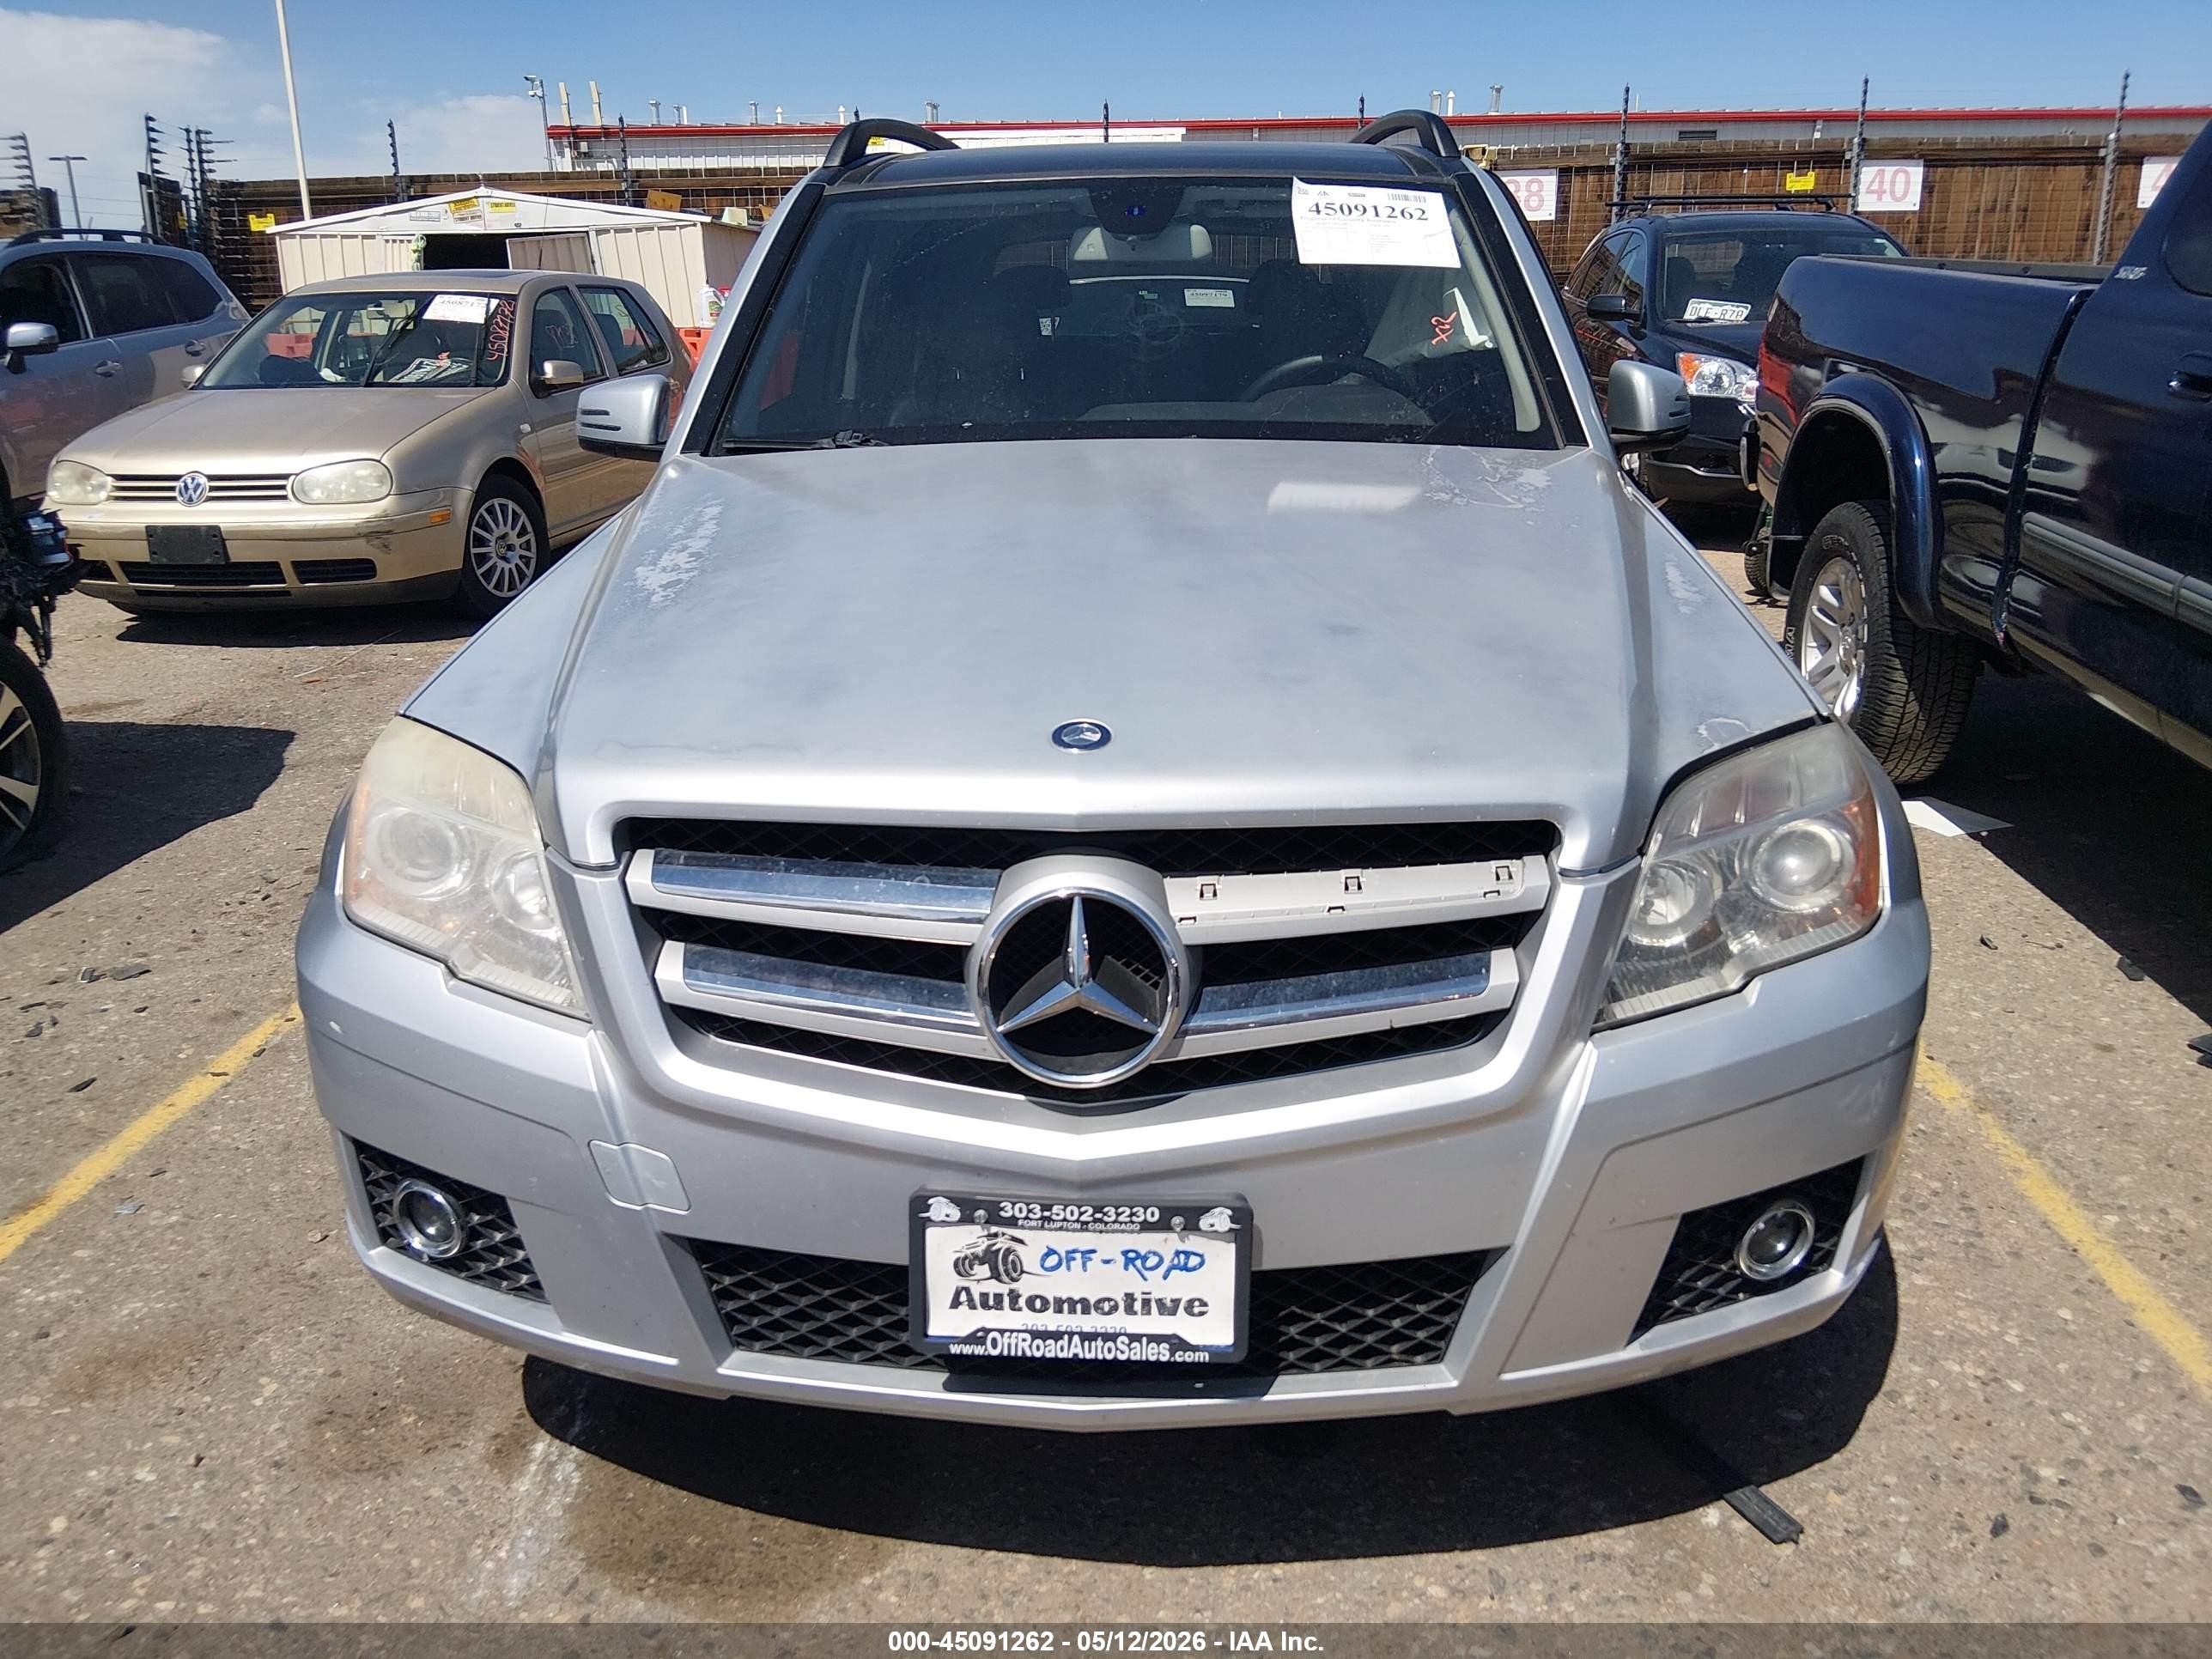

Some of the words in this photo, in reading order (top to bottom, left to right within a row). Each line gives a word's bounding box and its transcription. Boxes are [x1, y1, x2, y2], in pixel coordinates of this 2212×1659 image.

[1865, 167, 1911, 203] 40
[1308, 202, 1429, 222] 45091262
[999, 1201, 1160, 1224] 303-502-3230
[1018, 1219, 1043, 1228] FORT
[1044, 1220, 1082, 1230] LUPTON
[1088, 1222, 1141, 1231] COLORADO
[948, 1285, 1210, 1318] Automotive
[949, 1331, 1210, 1364] www.OffRoadAutoSales.com
